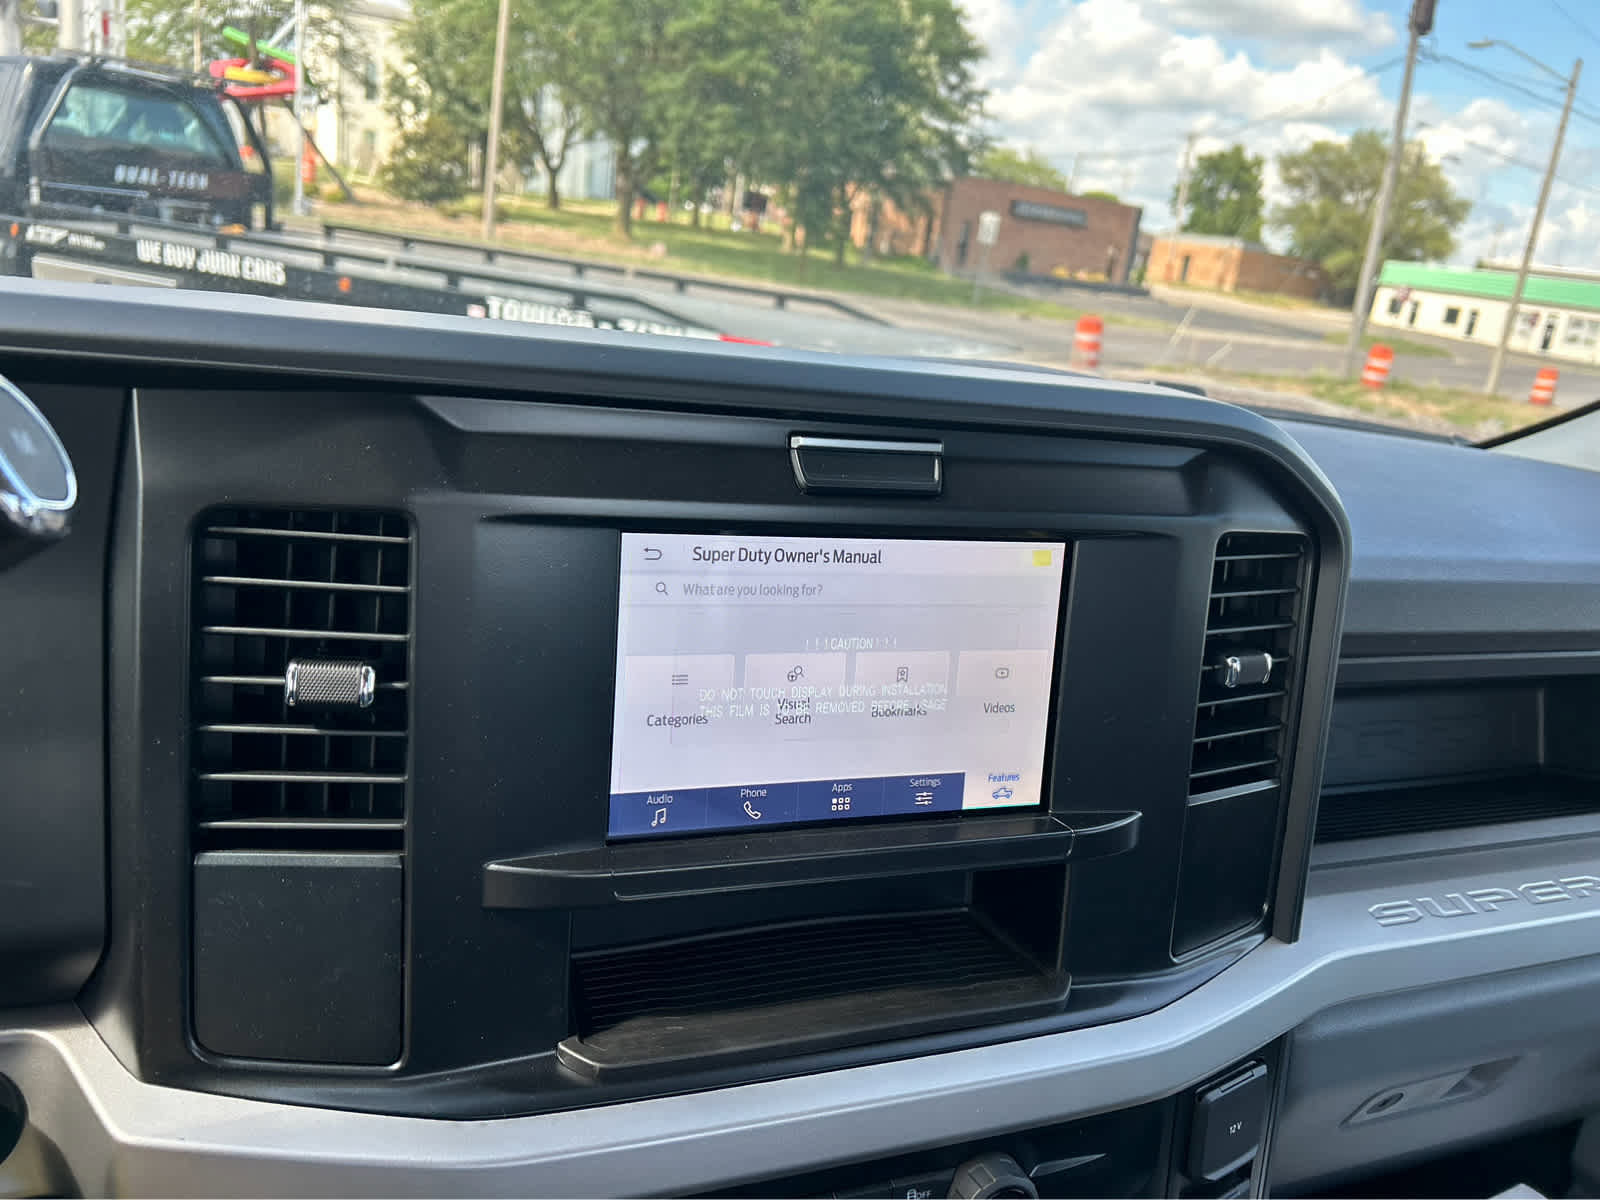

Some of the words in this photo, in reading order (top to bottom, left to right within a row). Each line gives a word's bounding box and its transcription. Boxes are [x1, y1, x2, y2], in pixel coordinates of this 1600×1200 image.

[136, 239, 162, 264] WE
[163, 242, 196, 270] BUY
[197, 249, 241, 278] JUNK
[241, 256, 286, 286] CARS
[692, 546, 735, 564] Super
[738, 547, 772, 565] Duty
[774, 548, 830, 563] Owner's
[832, 549, 882, 564] Manual
[683, 583, 715, 596] What
[717, 586, 735, 595] are
[737, 586, 757, 597] you
[759, 584, 799, 598] looking
[801, 584, 823, 597] for?
[831, 637, 873, 650] CAUTION
[699, 688, 716, 701] DO
[721, 688, 746, 700] NOT
[751, 688, 785, 699] TOUCH
[791, 685, 832, 698] DISPLAY
[840, 685, 876, 697] DURING
[730, 704, 754, 717] FILM
[816, 701, 865, 714] REMOVED
[777, 697, 811, 710] Visual
[983, 702, 1015, 714] Videos
[871, 704, 928, 718] Bookmarks
[646, 713, 708, 728] Categories
[775, 712, 811, 725] Search
[910, 777, 942, 789] Settings
[988, 772, 1020, 783] Features
[740, 788, 767, 799] Phone
[831, 782, 853, 793] Apps
[647, 793, 673, 805] Audio
[1367, 874, 1600, 928] SUPER
